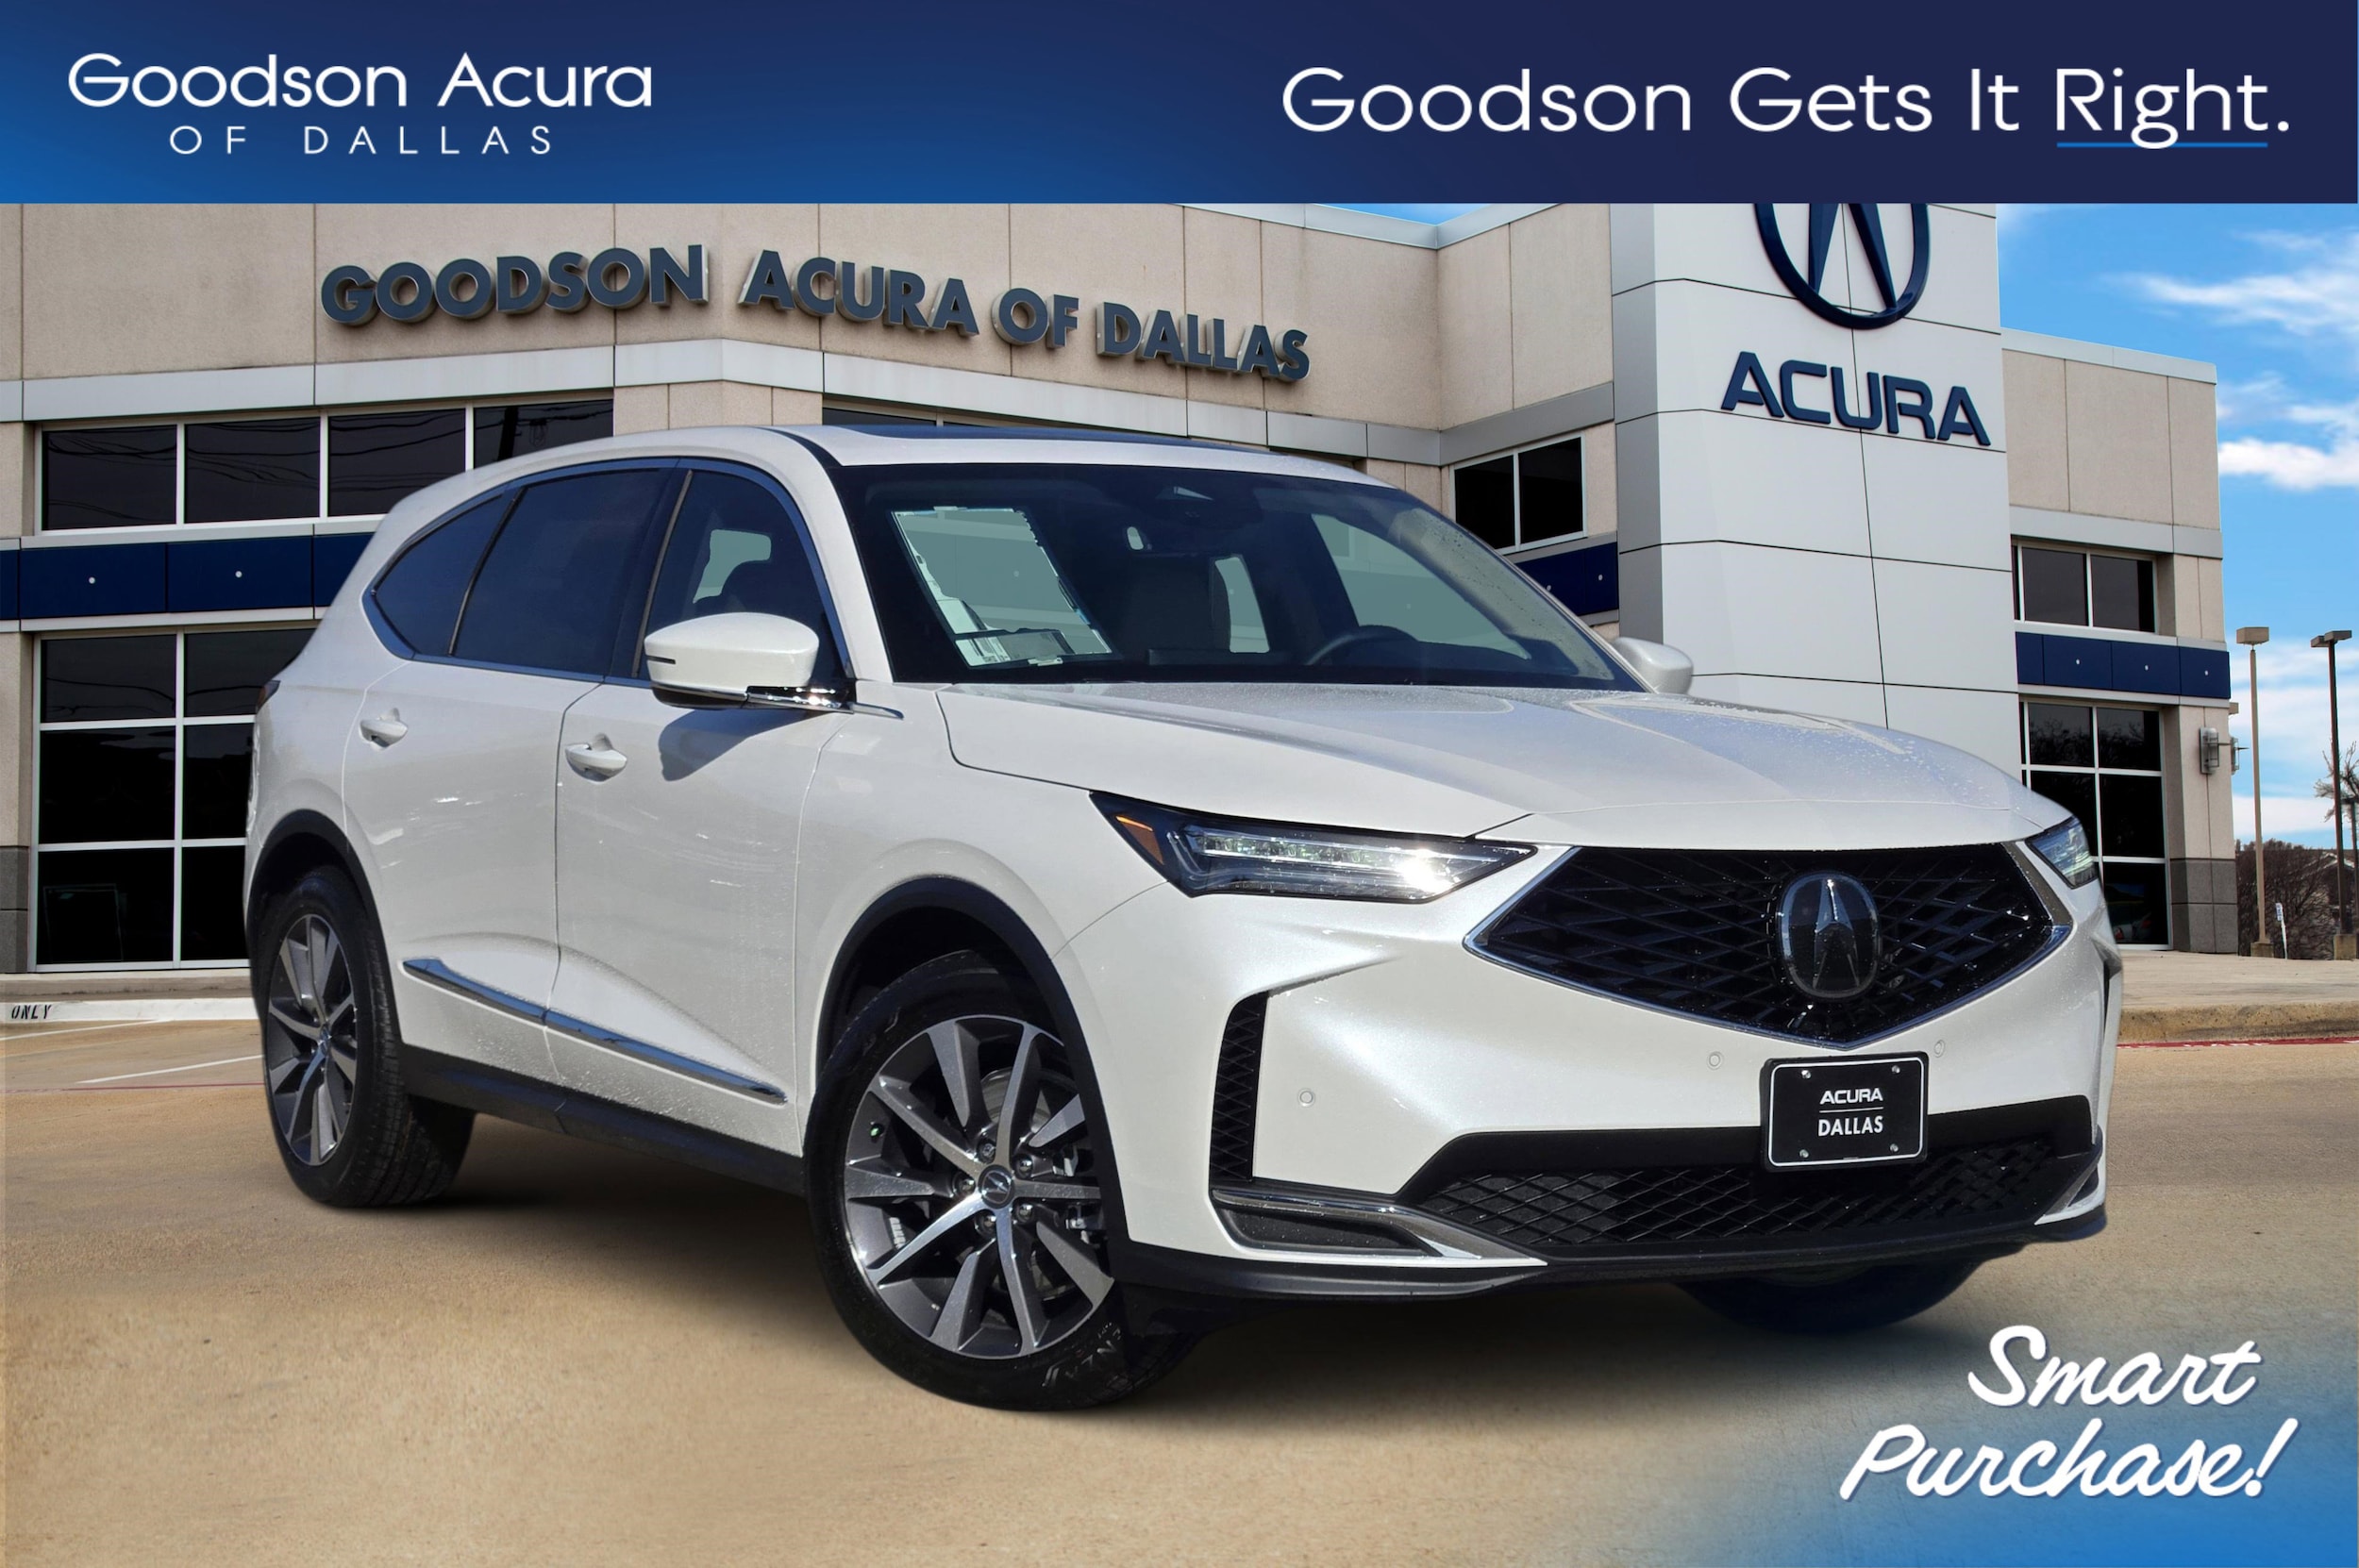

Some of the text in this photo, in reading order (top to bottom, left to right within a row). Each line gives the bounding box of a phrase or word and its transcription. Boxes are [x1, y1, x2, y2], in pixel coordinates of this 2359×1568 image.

[321, 244, 1311, 381] GOODSON ACURA OF DALLAS
[1720, 350, 1991, 446] ACURA
[11, 1005, 52, 1020] ONLY
[1819, 1088, 1884, 1105] ACURA
[1817, 1115, 1883, 1137] DALLAS
